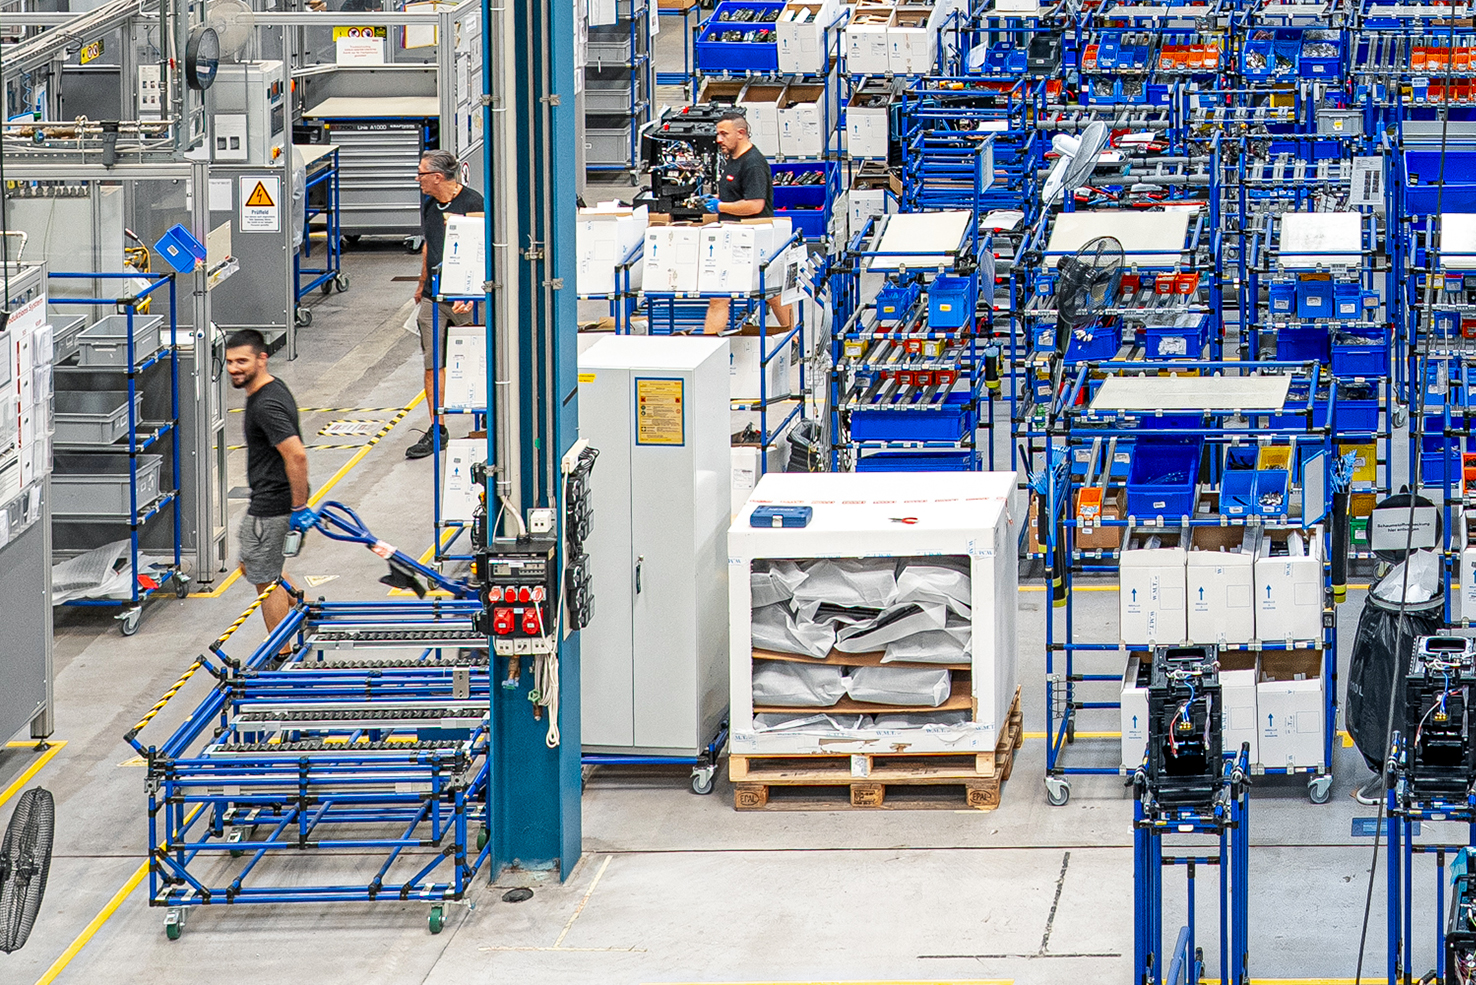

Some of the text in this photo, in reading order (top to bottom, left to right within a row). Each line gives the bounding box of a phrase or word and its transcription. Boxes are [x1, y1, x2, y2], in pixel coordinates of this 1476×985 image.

[28, 298, 43, 312] System
[740, 794, 757, 804] EPAL
[972, 791, 988, 801] EPAL
